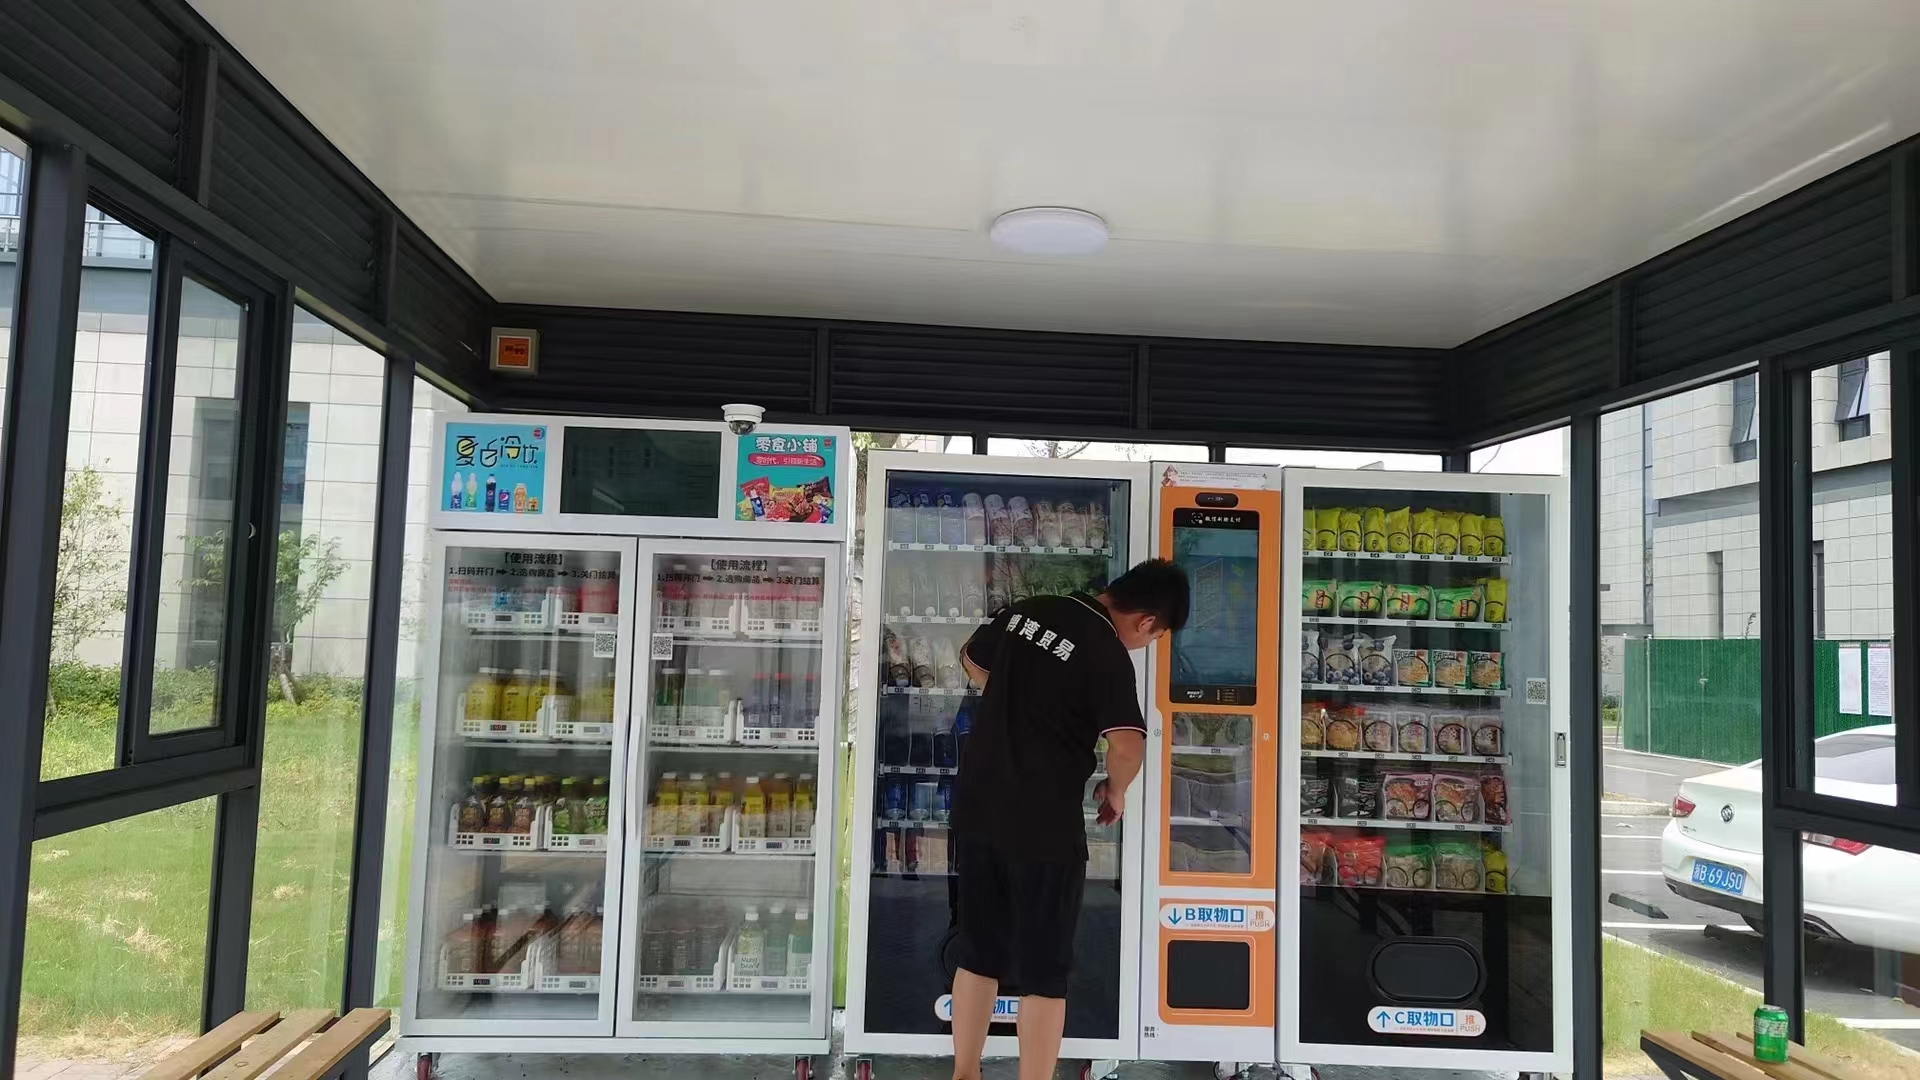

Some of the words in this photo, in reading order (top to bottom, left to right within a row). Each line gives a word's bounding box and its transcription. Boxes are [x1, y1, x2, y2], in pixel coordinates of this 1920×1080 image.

[756, 437, 818, 453] 零食小铺
[1185, 907, 1244, 922] B取物口
[1255, 910, 1264, 920] 推
[1250, 920, 1270, 928] PUSH
[1395, 1010, 1454, 1027] C取物口
[1465, 1014, 1475, 1024] 推
[1460, 1024, 1481, 1032] PUSH
